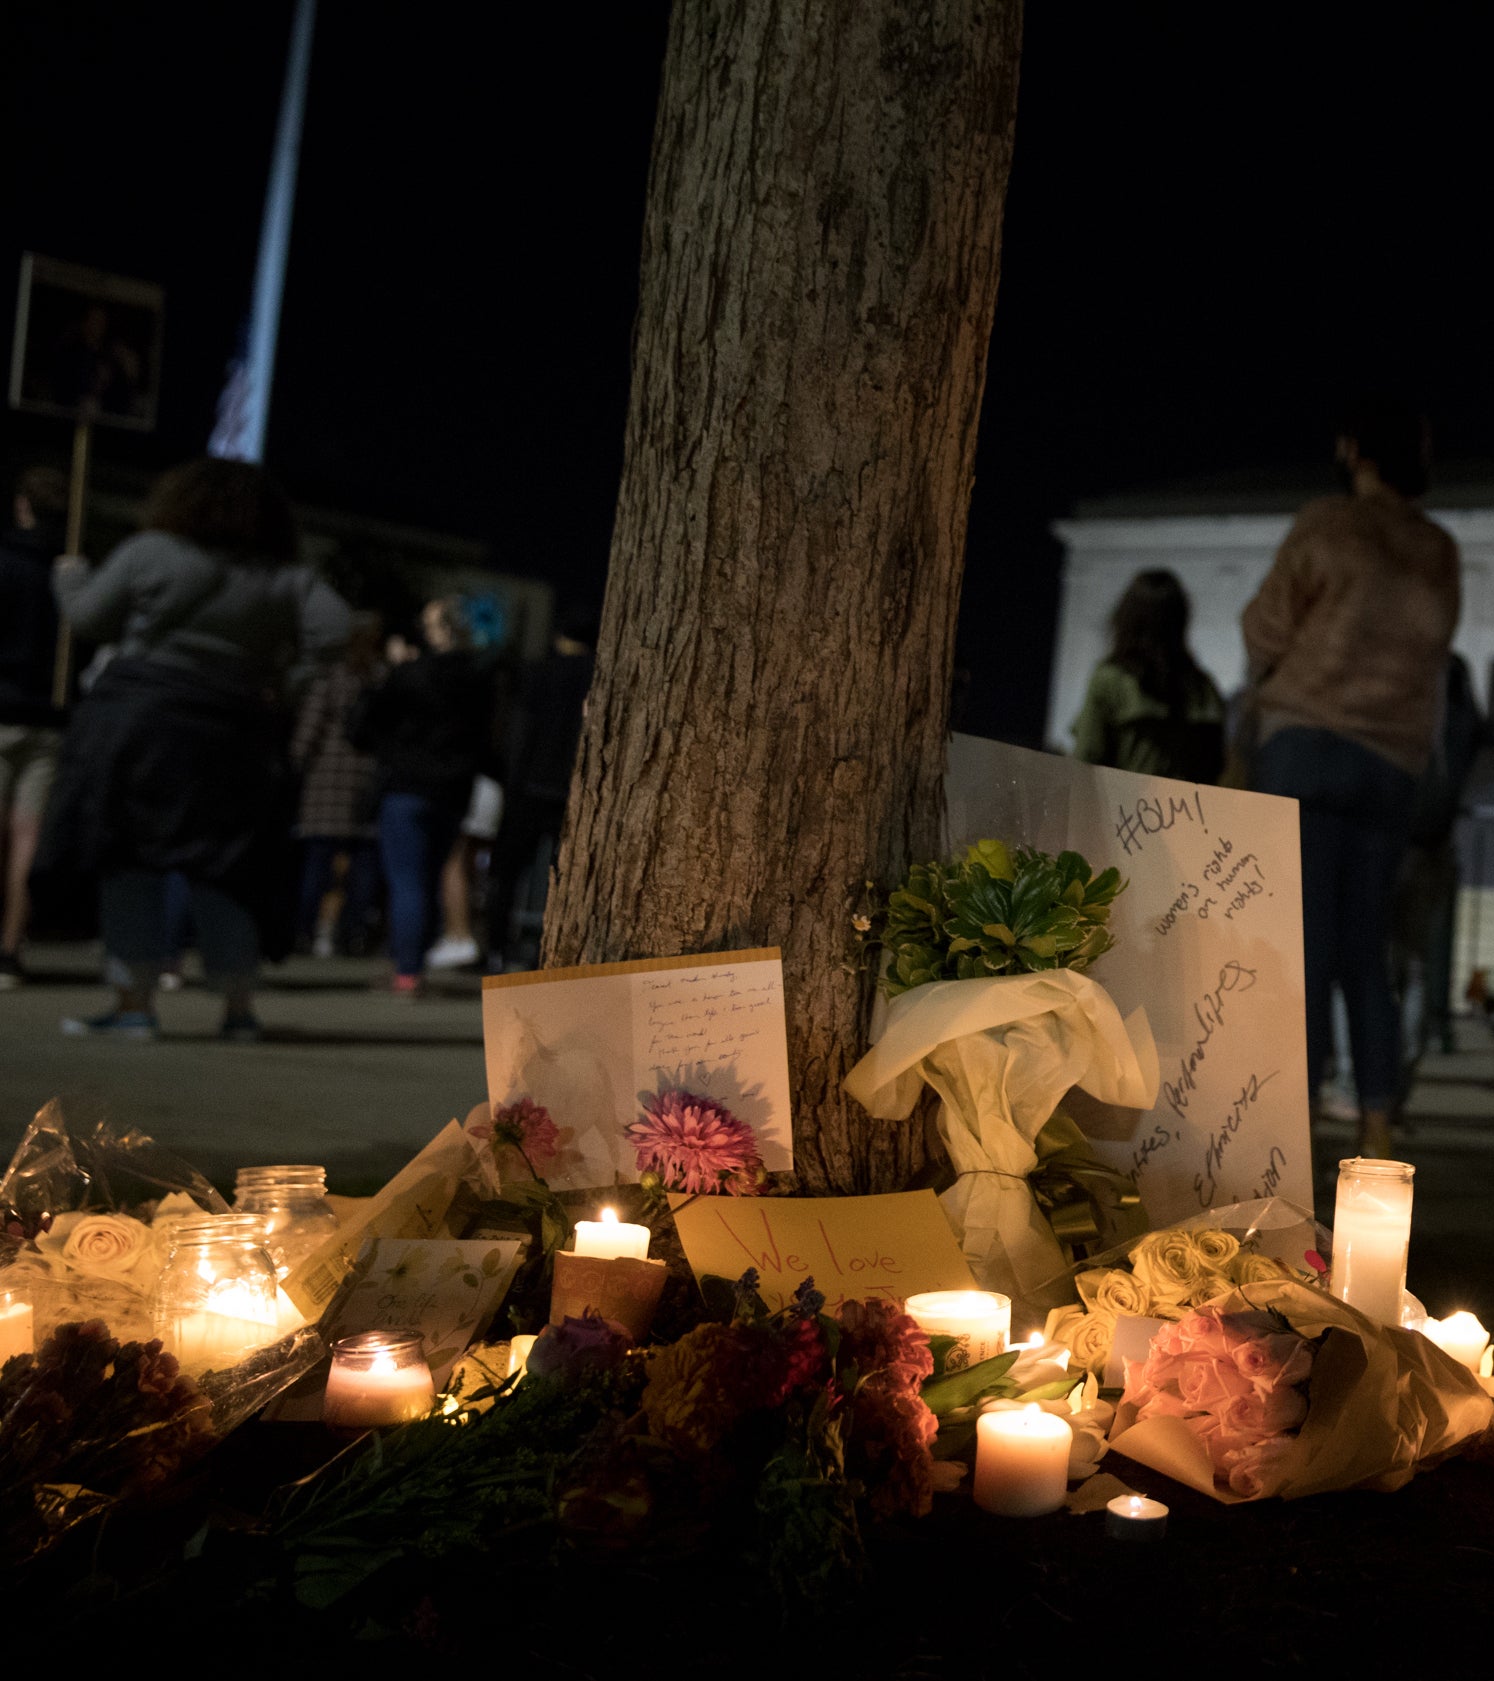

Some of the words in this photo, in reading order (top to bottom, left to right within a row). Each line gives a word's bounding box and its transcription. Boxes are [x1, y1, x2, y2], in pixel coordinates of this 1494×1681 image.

[1116, 791, 1209, 856] #BLM!
[715, 1208, 810, 1273] We
[817, 1219, 903, 1276] love
